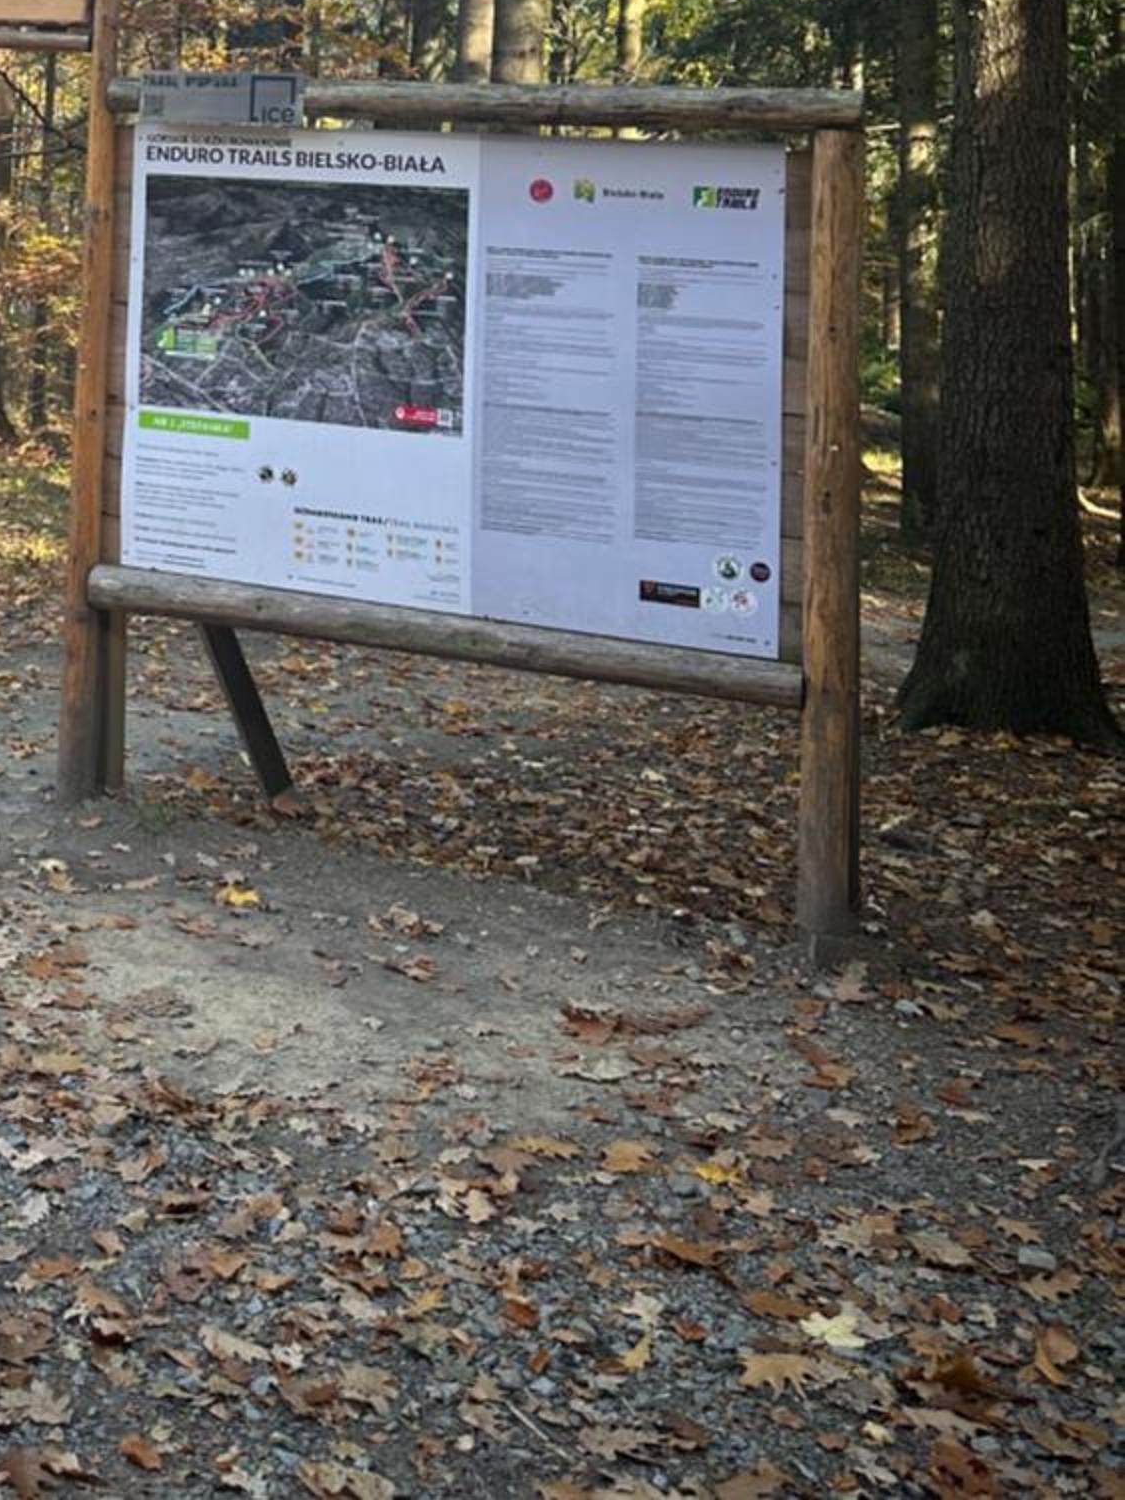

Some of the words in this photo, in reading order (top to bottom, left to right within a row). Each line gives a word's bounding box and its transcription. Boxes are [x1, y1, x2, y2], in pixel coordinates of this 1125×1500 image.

[146, 145, 224, 164] ENDURO
[229, 148, 293, 167] TRAILS
[296, 151, 446, 174] BIELSKO-BIAŁA
